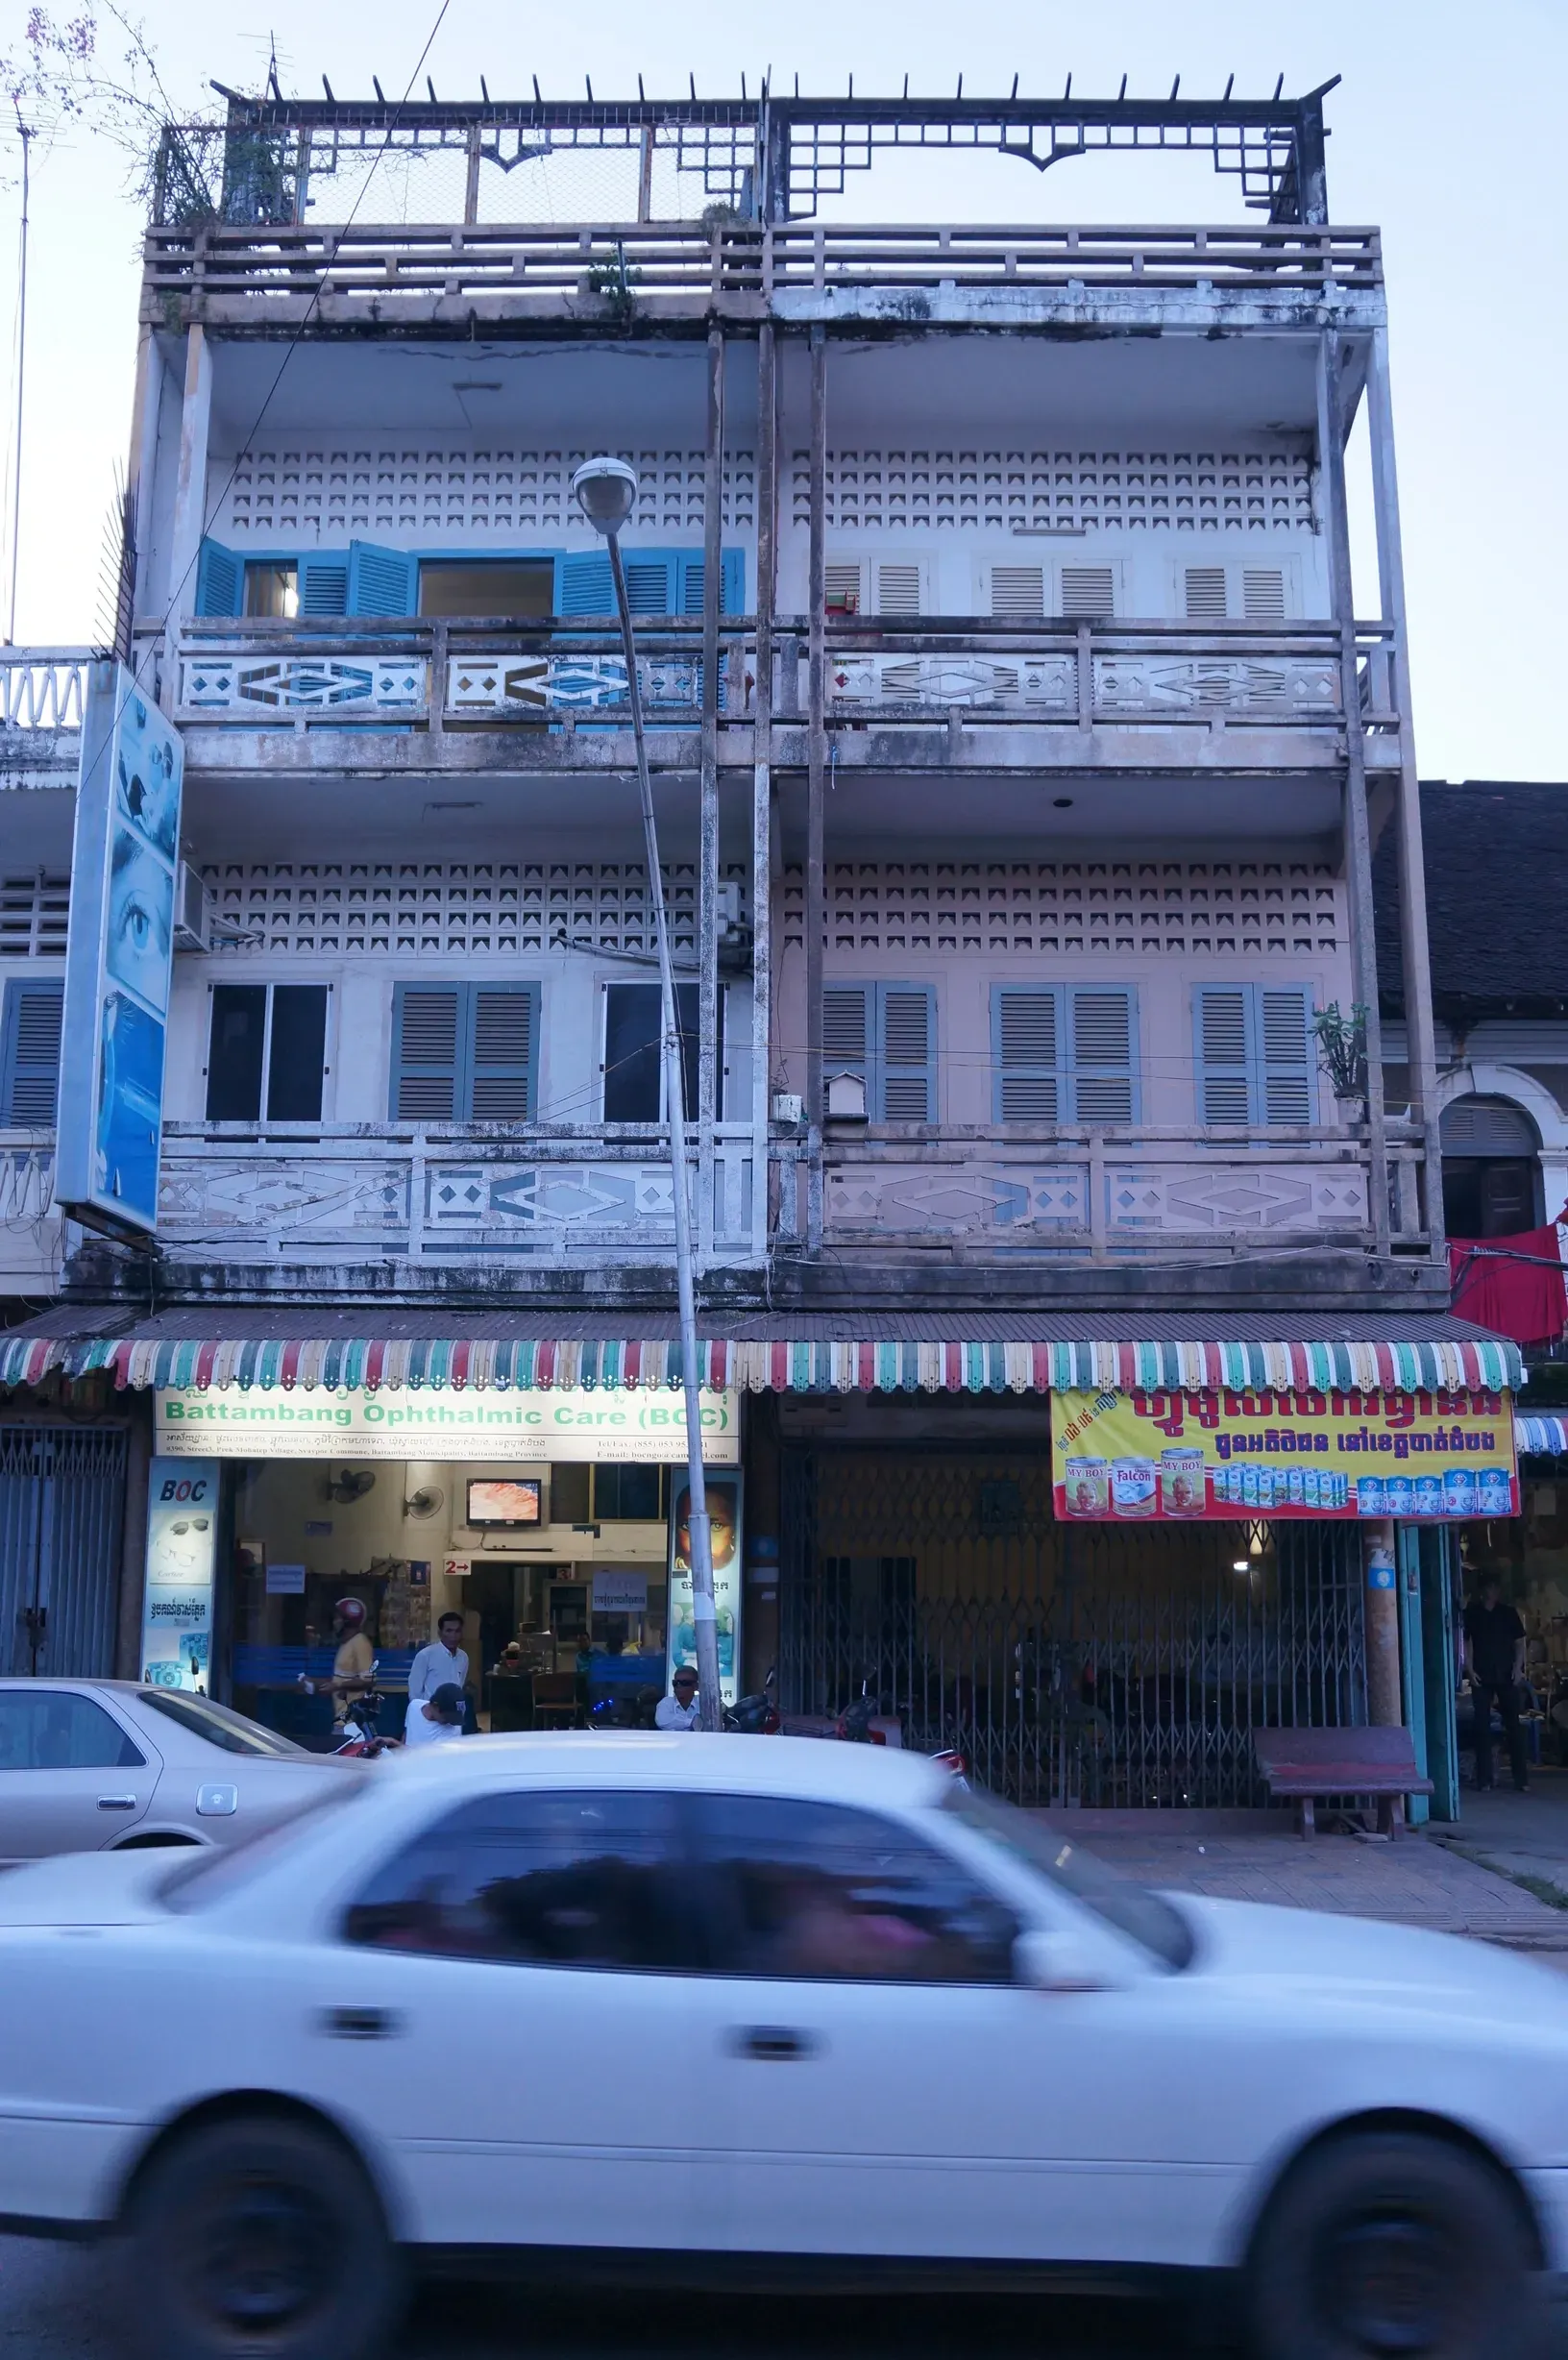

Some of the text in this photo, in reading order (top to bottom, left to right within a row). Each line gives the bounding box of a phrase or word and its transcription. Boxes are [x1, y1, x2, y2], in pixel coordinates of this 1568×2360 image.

[165, 1401, 352, 1426] Battambang
[363, 1404, 542, 1427] Ophthalmic
[554, 1407, 626, 1425] Care
[634, 1440, 656, 1449] (855)
[1164, 1461, 1202, 1471] MY BOY
[1067, 1467, 1105, 1478] MY BOY
[1116, 1470, 1151, 1482] Falcon
[159, 1479, 208, 1502] BOC
[445, 1560, 456, 1574] 2
